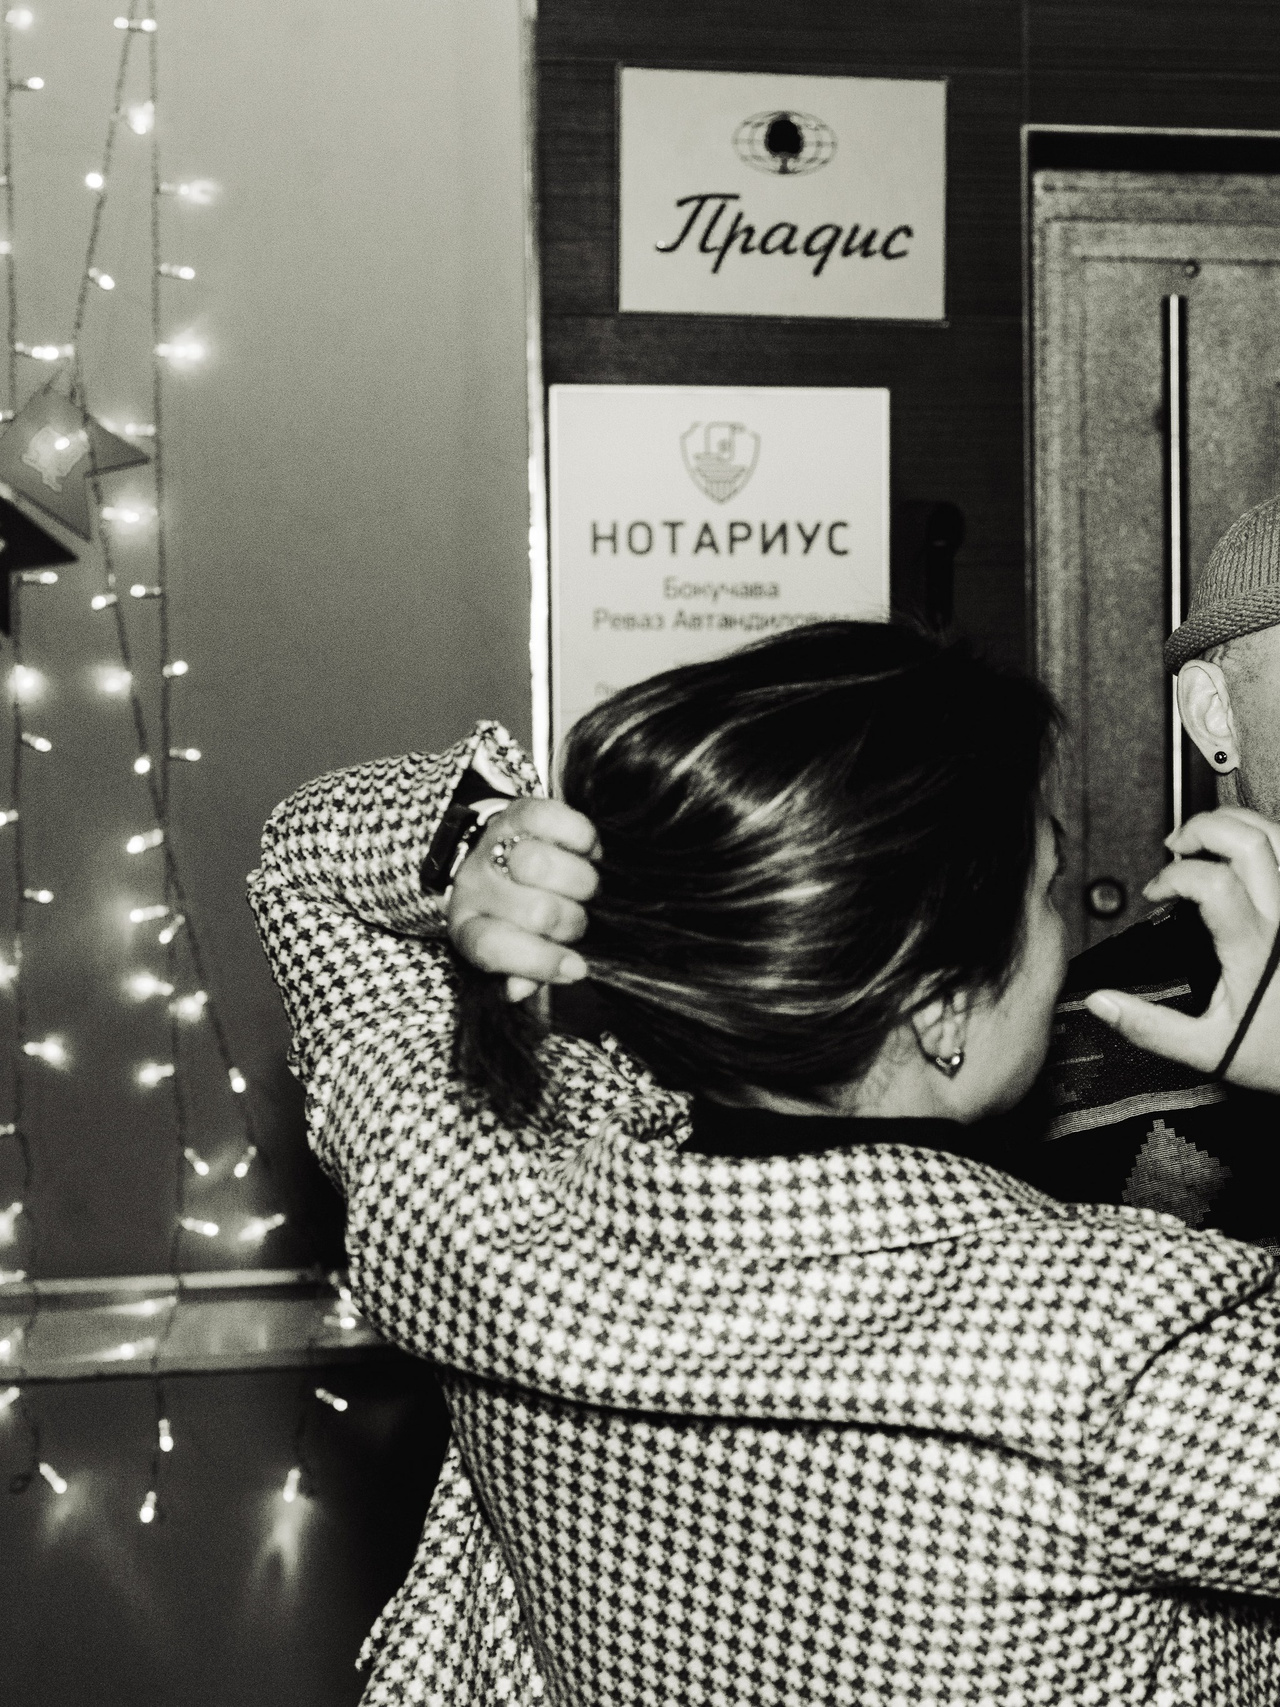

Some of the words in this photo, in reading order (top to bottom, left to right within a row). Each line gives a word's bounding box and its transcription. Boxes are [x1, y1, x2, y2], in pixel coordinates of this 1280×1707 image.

[656, 193, 914, 276] Прадис
[591, 519, 850, 556] НОТАРИУС
[593, 607, 665, 630] Реваз
